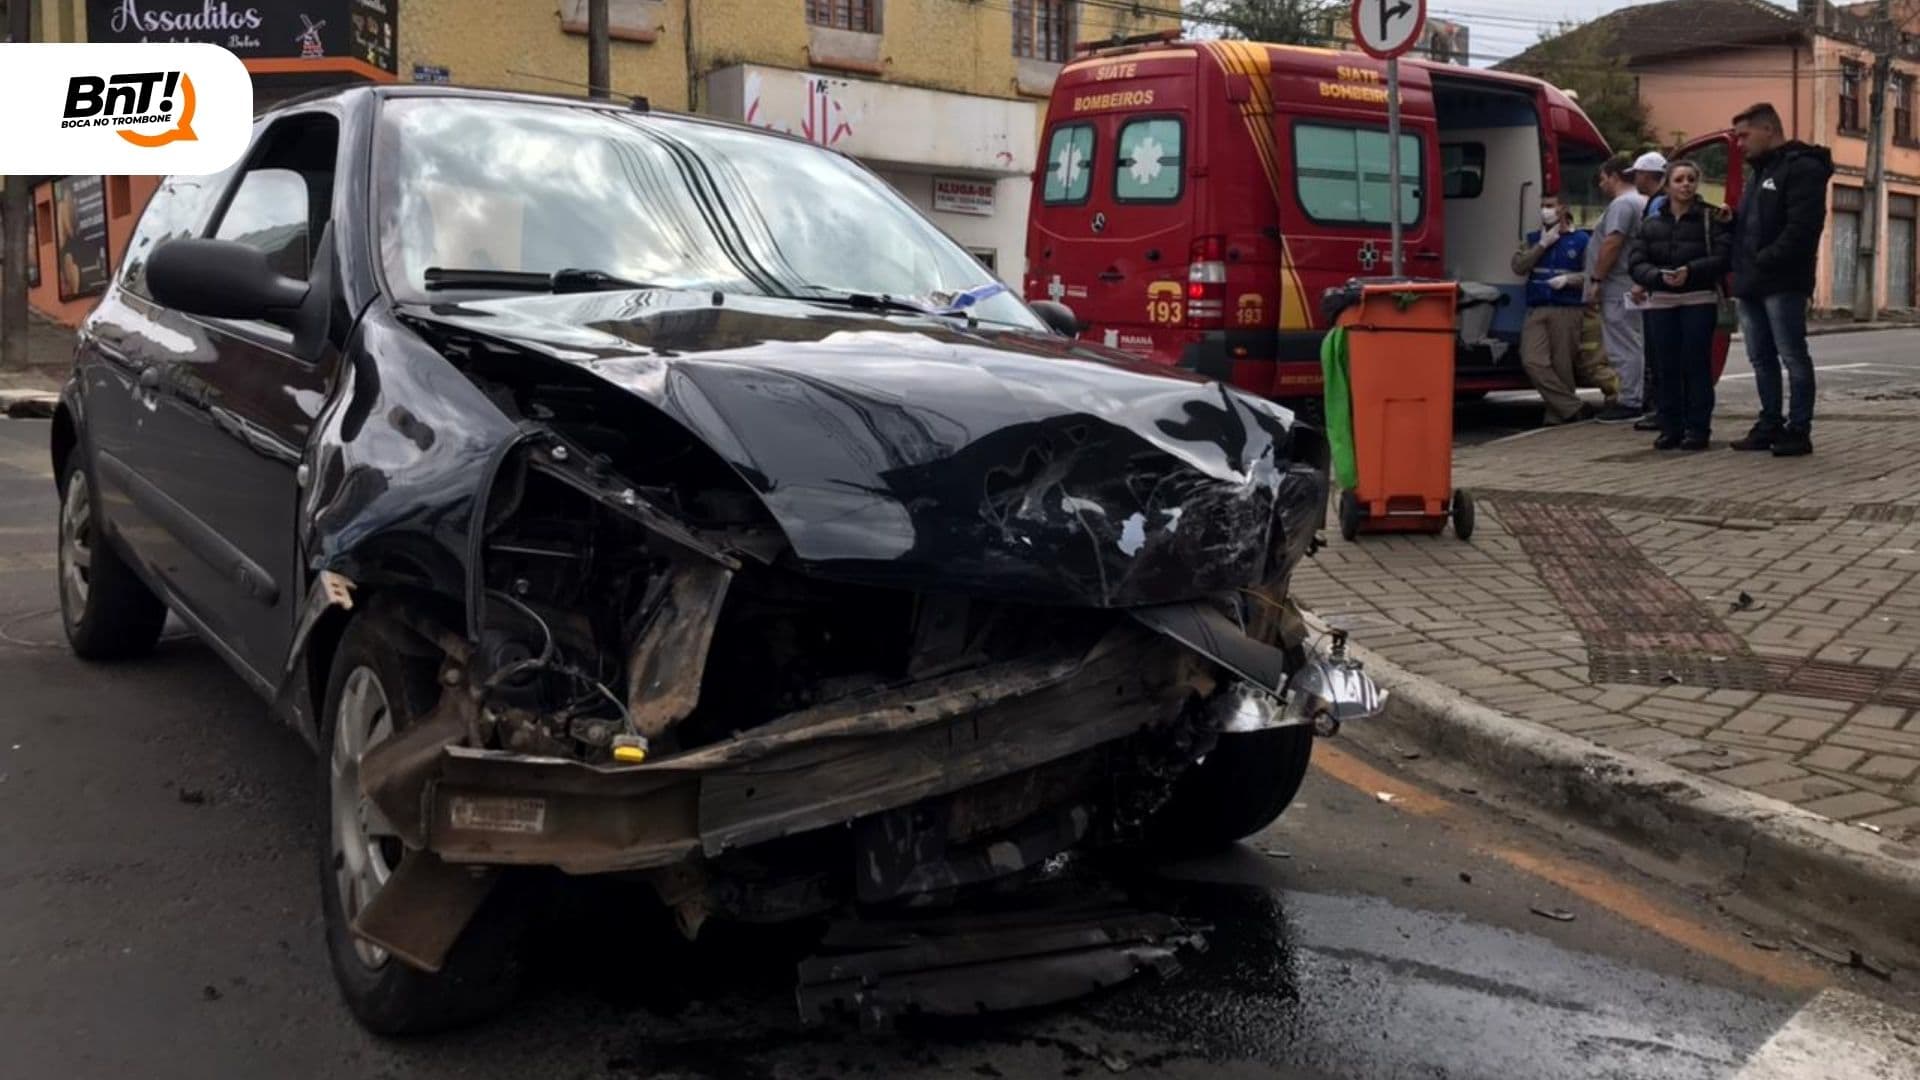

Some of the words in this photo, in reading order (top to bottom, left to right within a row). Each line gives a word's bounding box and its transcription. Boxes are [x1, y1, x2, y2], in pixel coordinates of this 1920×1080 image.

[111, 0, 263, 32] Assaditos
[1096, 63, 1137, 80] SIATE
[1337, 66, 1379, 81] SIATE
[1074, 90, 1154, 112] BOMBEIROS
[937, 182, 993, 197] ALUGA-SE
[1147, 301, 1182, 322] 193
[1236, 308, 1263, 323] 193
[1120, 335, 1153, 345] PARANÁ
